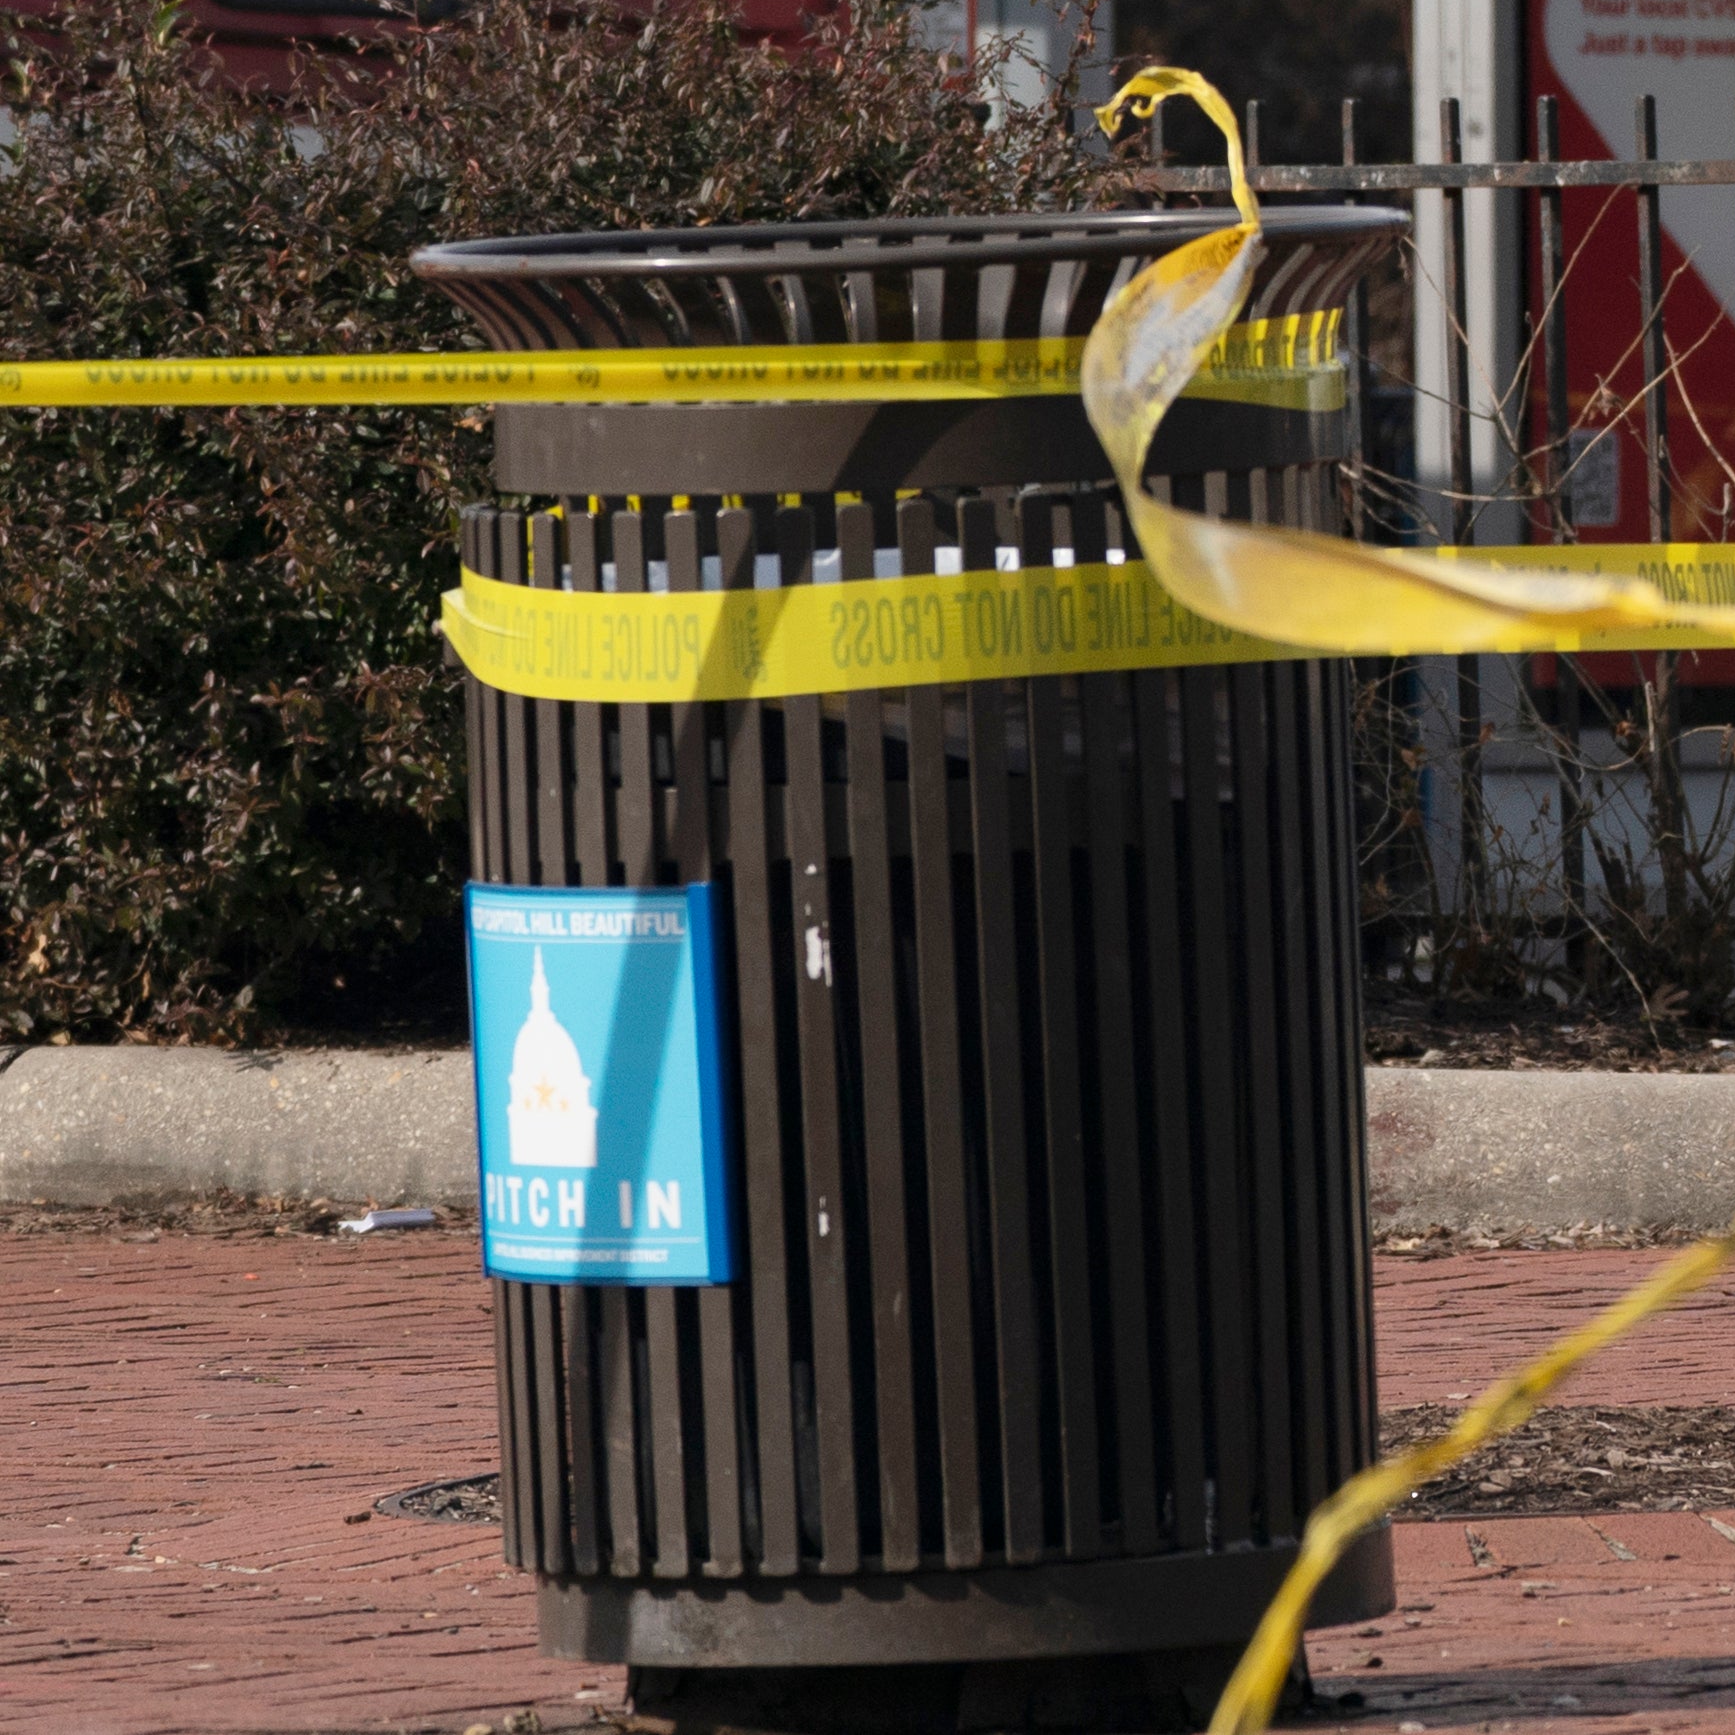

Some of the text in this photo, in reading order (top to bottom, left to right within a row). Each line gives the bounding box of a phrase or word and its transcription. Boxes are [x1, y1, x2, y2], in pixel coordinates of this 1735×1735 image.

[569, 910, 685, 937] BEAUTIFUL
[487, 1172, 682, 1230] PITCH IN
